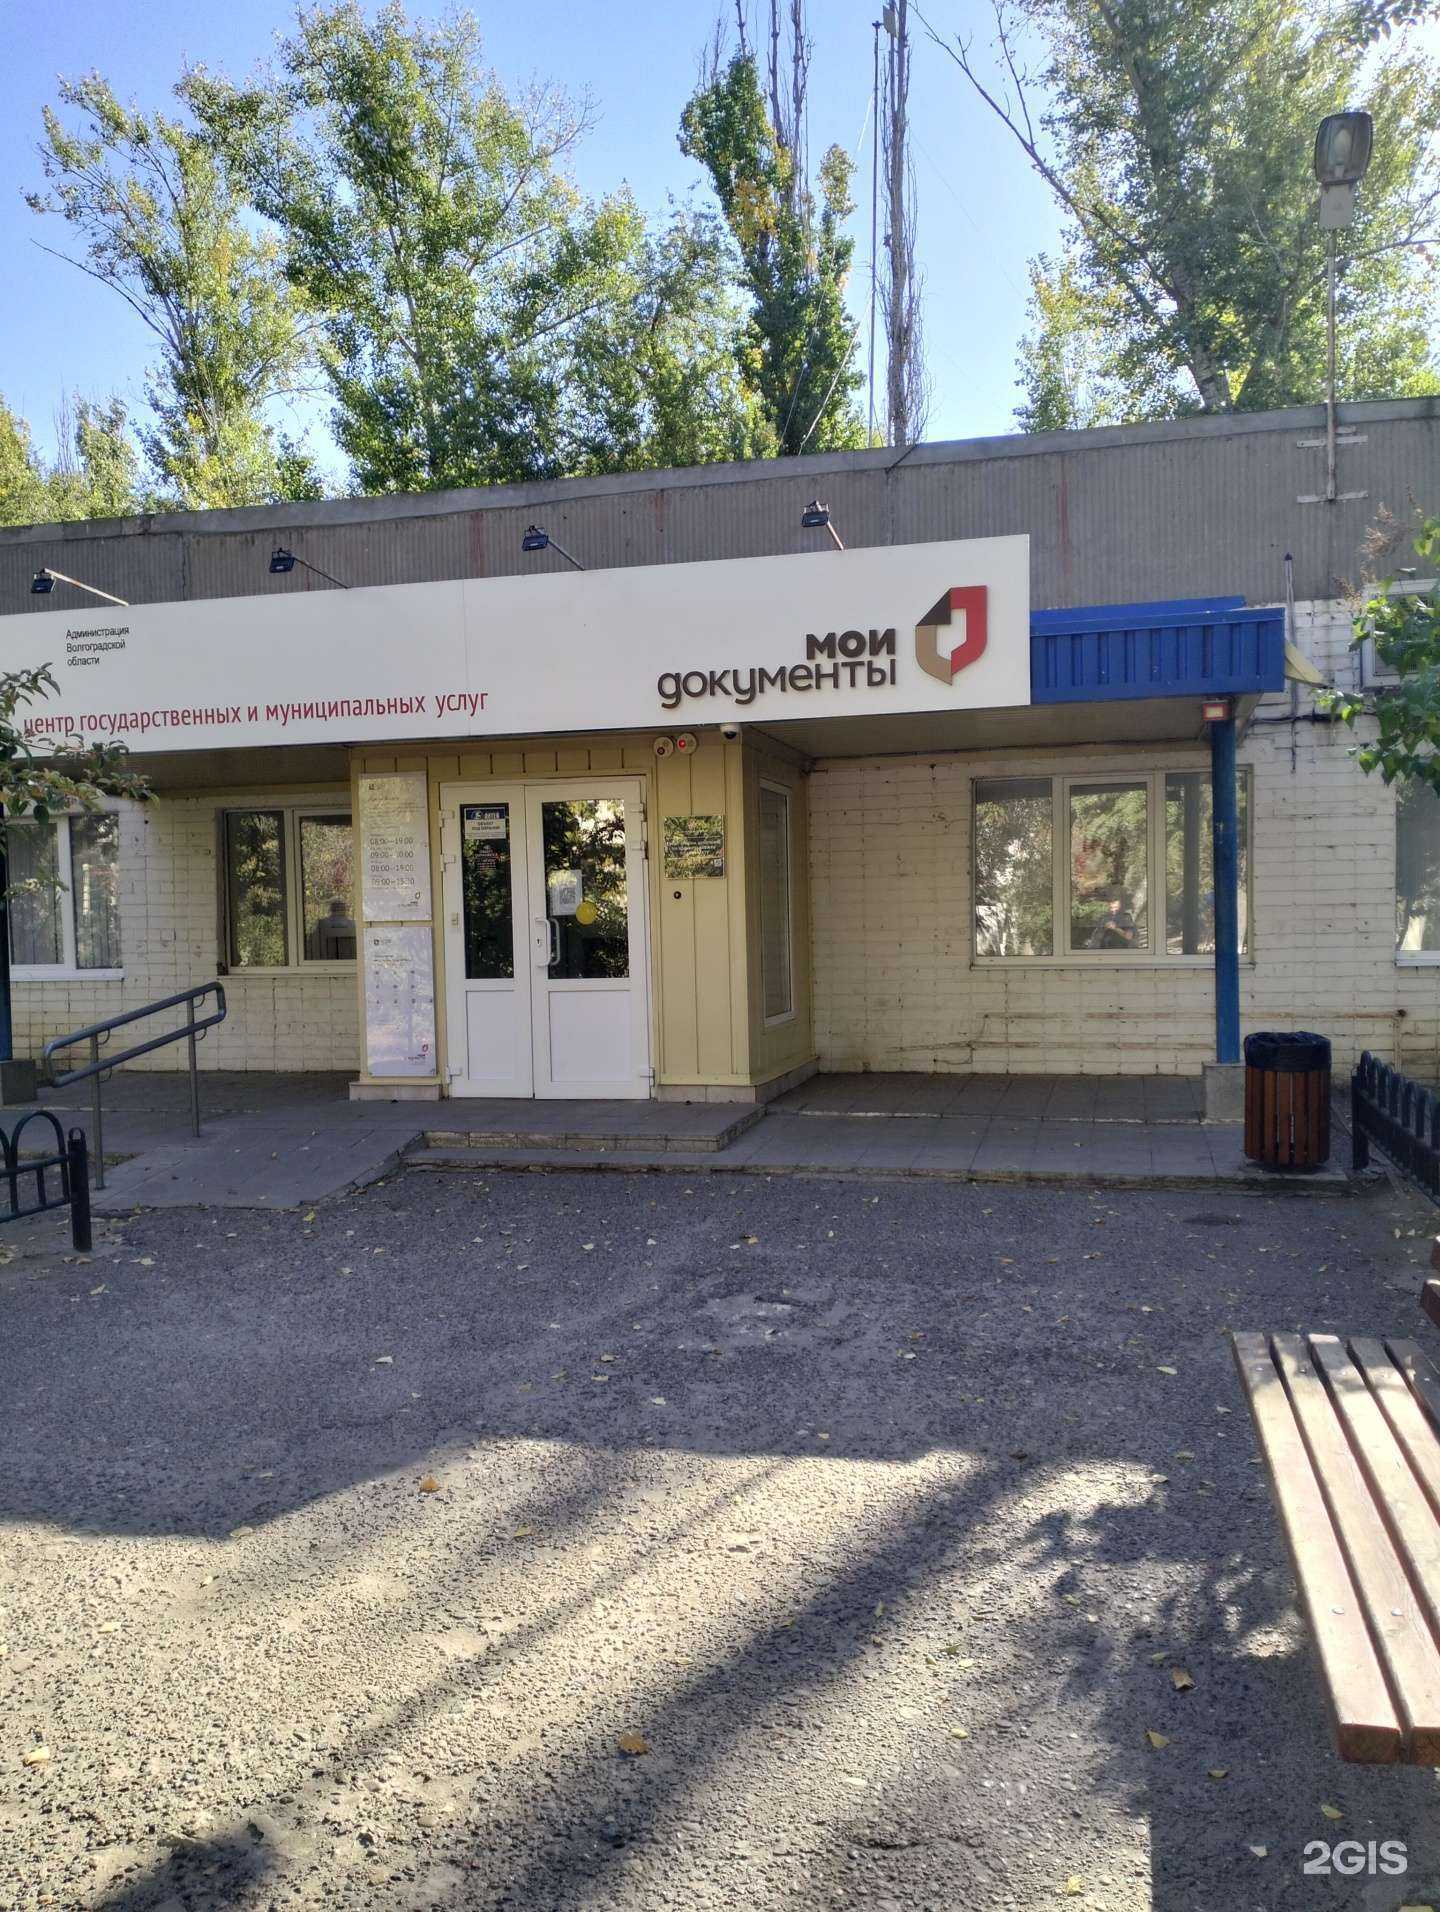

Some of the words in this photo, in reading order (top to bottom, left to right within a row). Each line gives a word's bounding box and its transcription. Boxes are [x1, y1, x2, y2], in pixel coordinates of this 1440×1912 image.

[66, 627, 130, 641] Администрация
[66, 639, 126, 653] Волгоградской
[67, 656, 100, 666] области
[658, 658, 897, 709] документы
[79, 705, 241, 735] государственных
[248, 704, 260, 722] и
[266, 695, 425, 727] муниципальных
[436, 689, 489, 717] услуг
